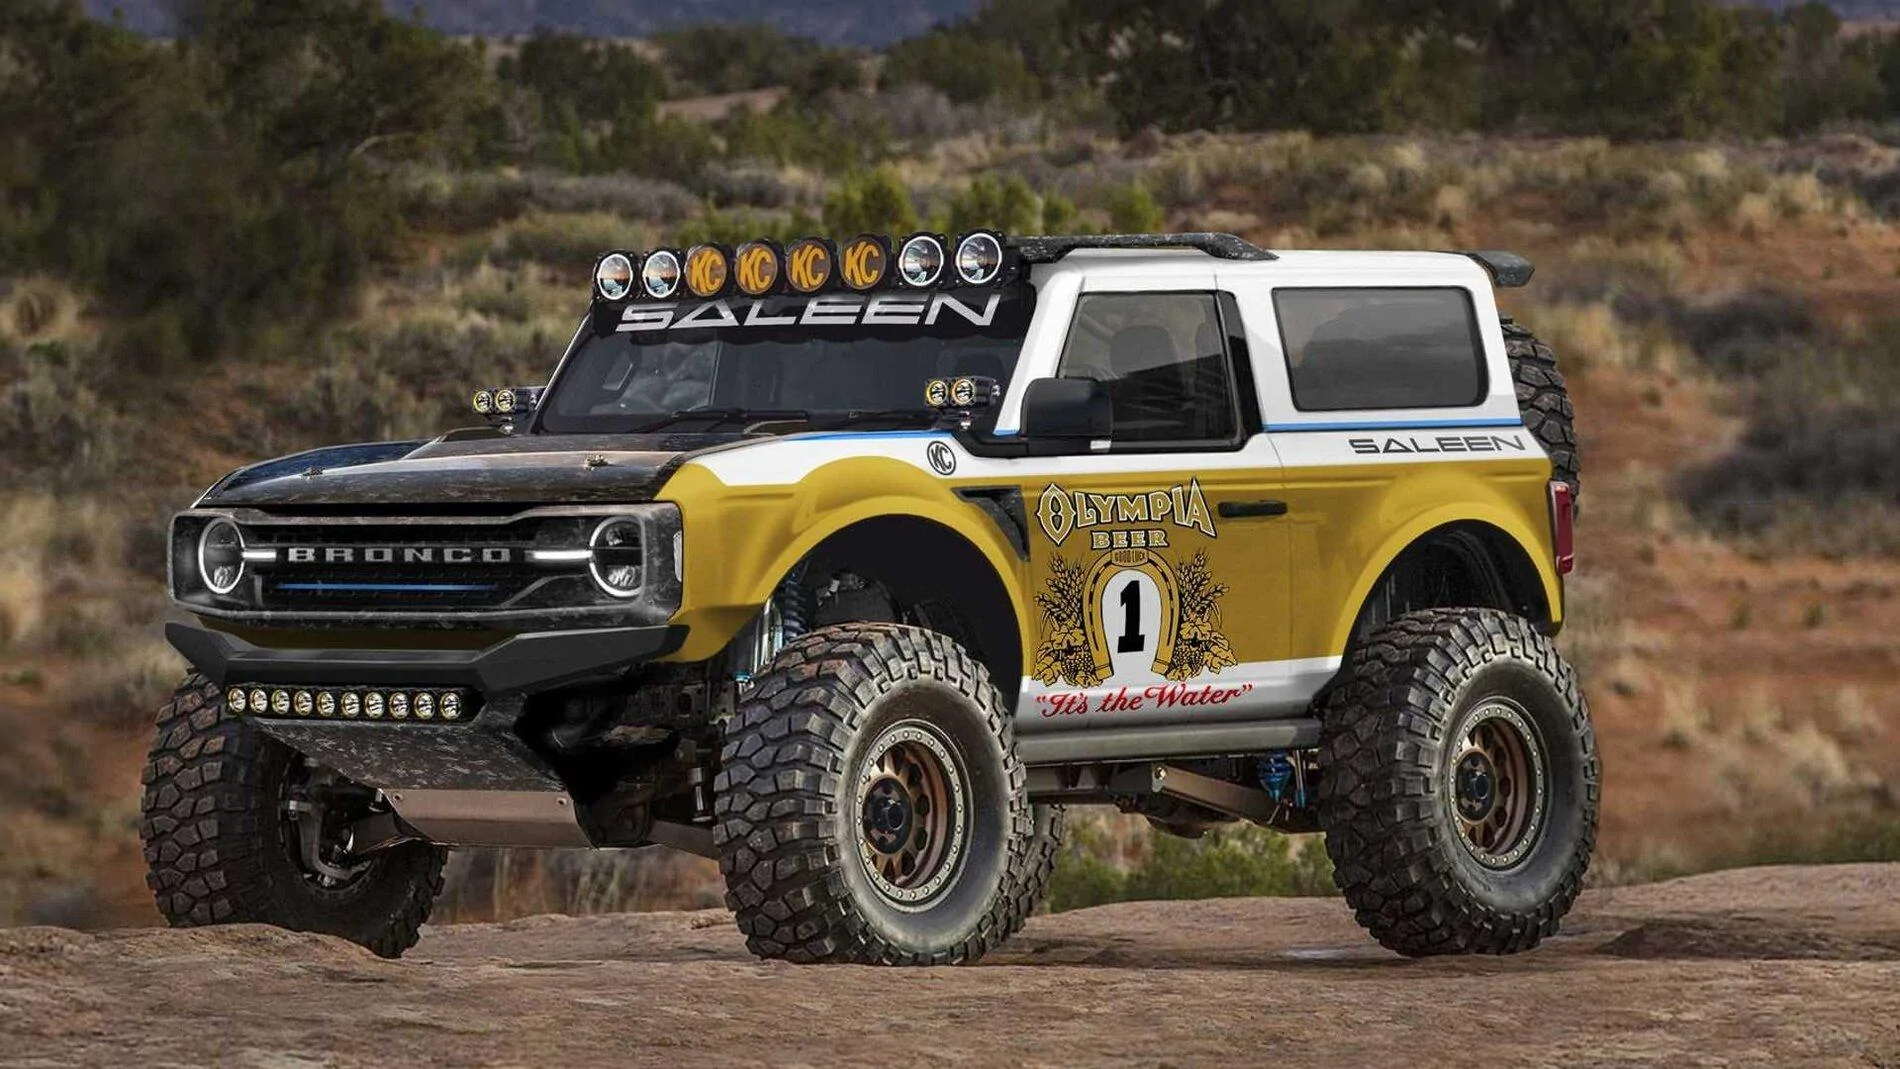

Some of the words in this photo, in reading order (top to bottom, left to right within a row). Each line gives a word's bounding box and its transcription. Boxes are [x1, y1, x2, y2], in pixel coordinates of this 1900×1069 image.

[691, 250, 723, 294] KC
[739, 247, 771, 291] KC
[792, 244, 825, 289] KC
[846, 241, 879, 286] KC
[615, 294, 1001, 332] SALEEN
[930, 444, 953, 472] KC
[1349, 435, 1525, 453] SALEEN
[288, 547, 511, 563] BRONCO
[1091, 529, 1170, 550] BEER
[1117, 580, 1145, 654] 1
[1094, 688, 1143, 713] the
